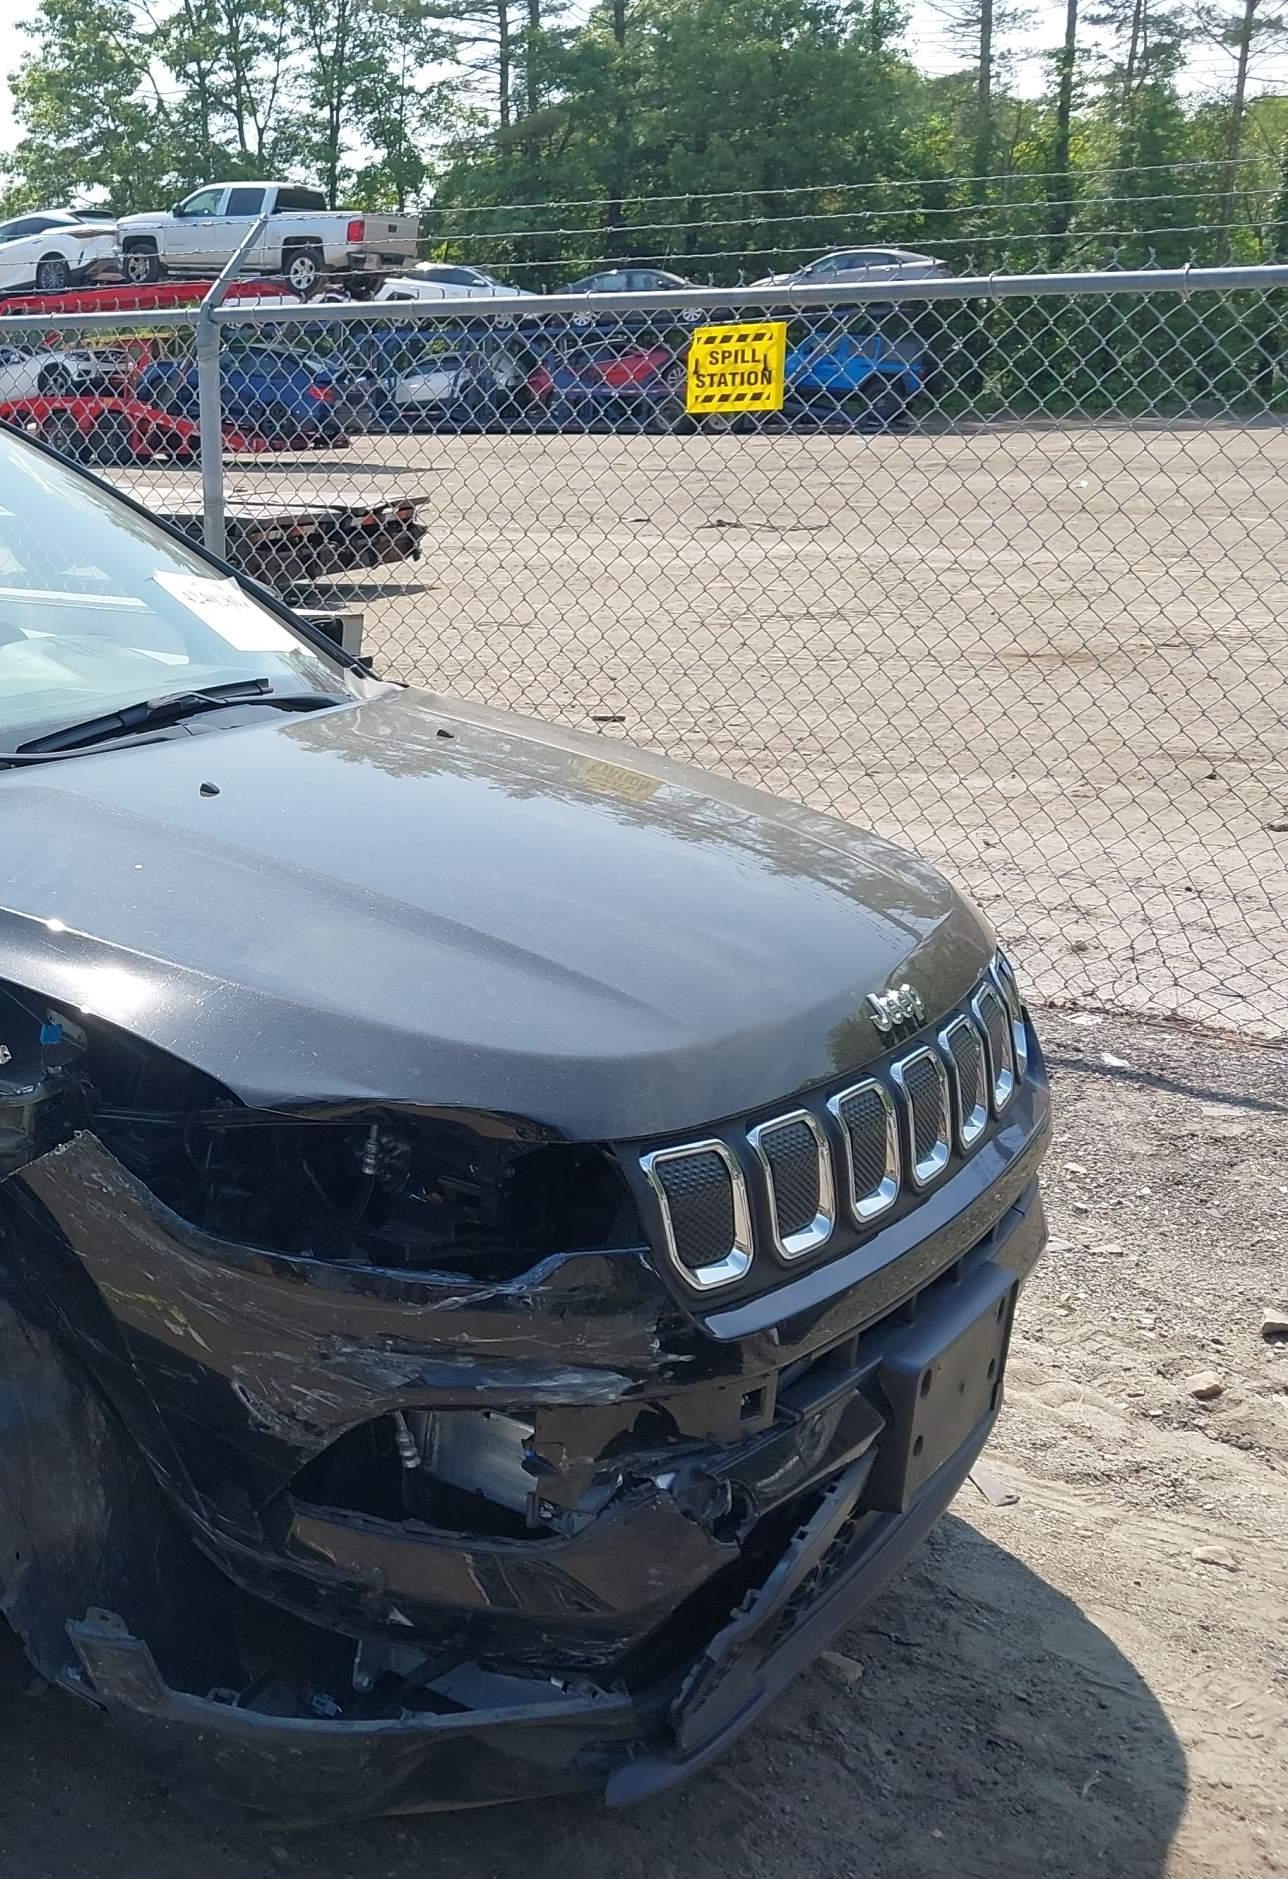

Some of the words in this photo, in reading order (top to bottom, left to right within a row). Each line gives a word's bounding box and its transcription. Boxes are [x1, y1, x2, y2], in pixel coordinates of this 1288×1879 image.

[708, 348, 761, 366] SPILL
[695, 369, 773, 389] STATION
[865, 983, 926, 1032] Jeep
